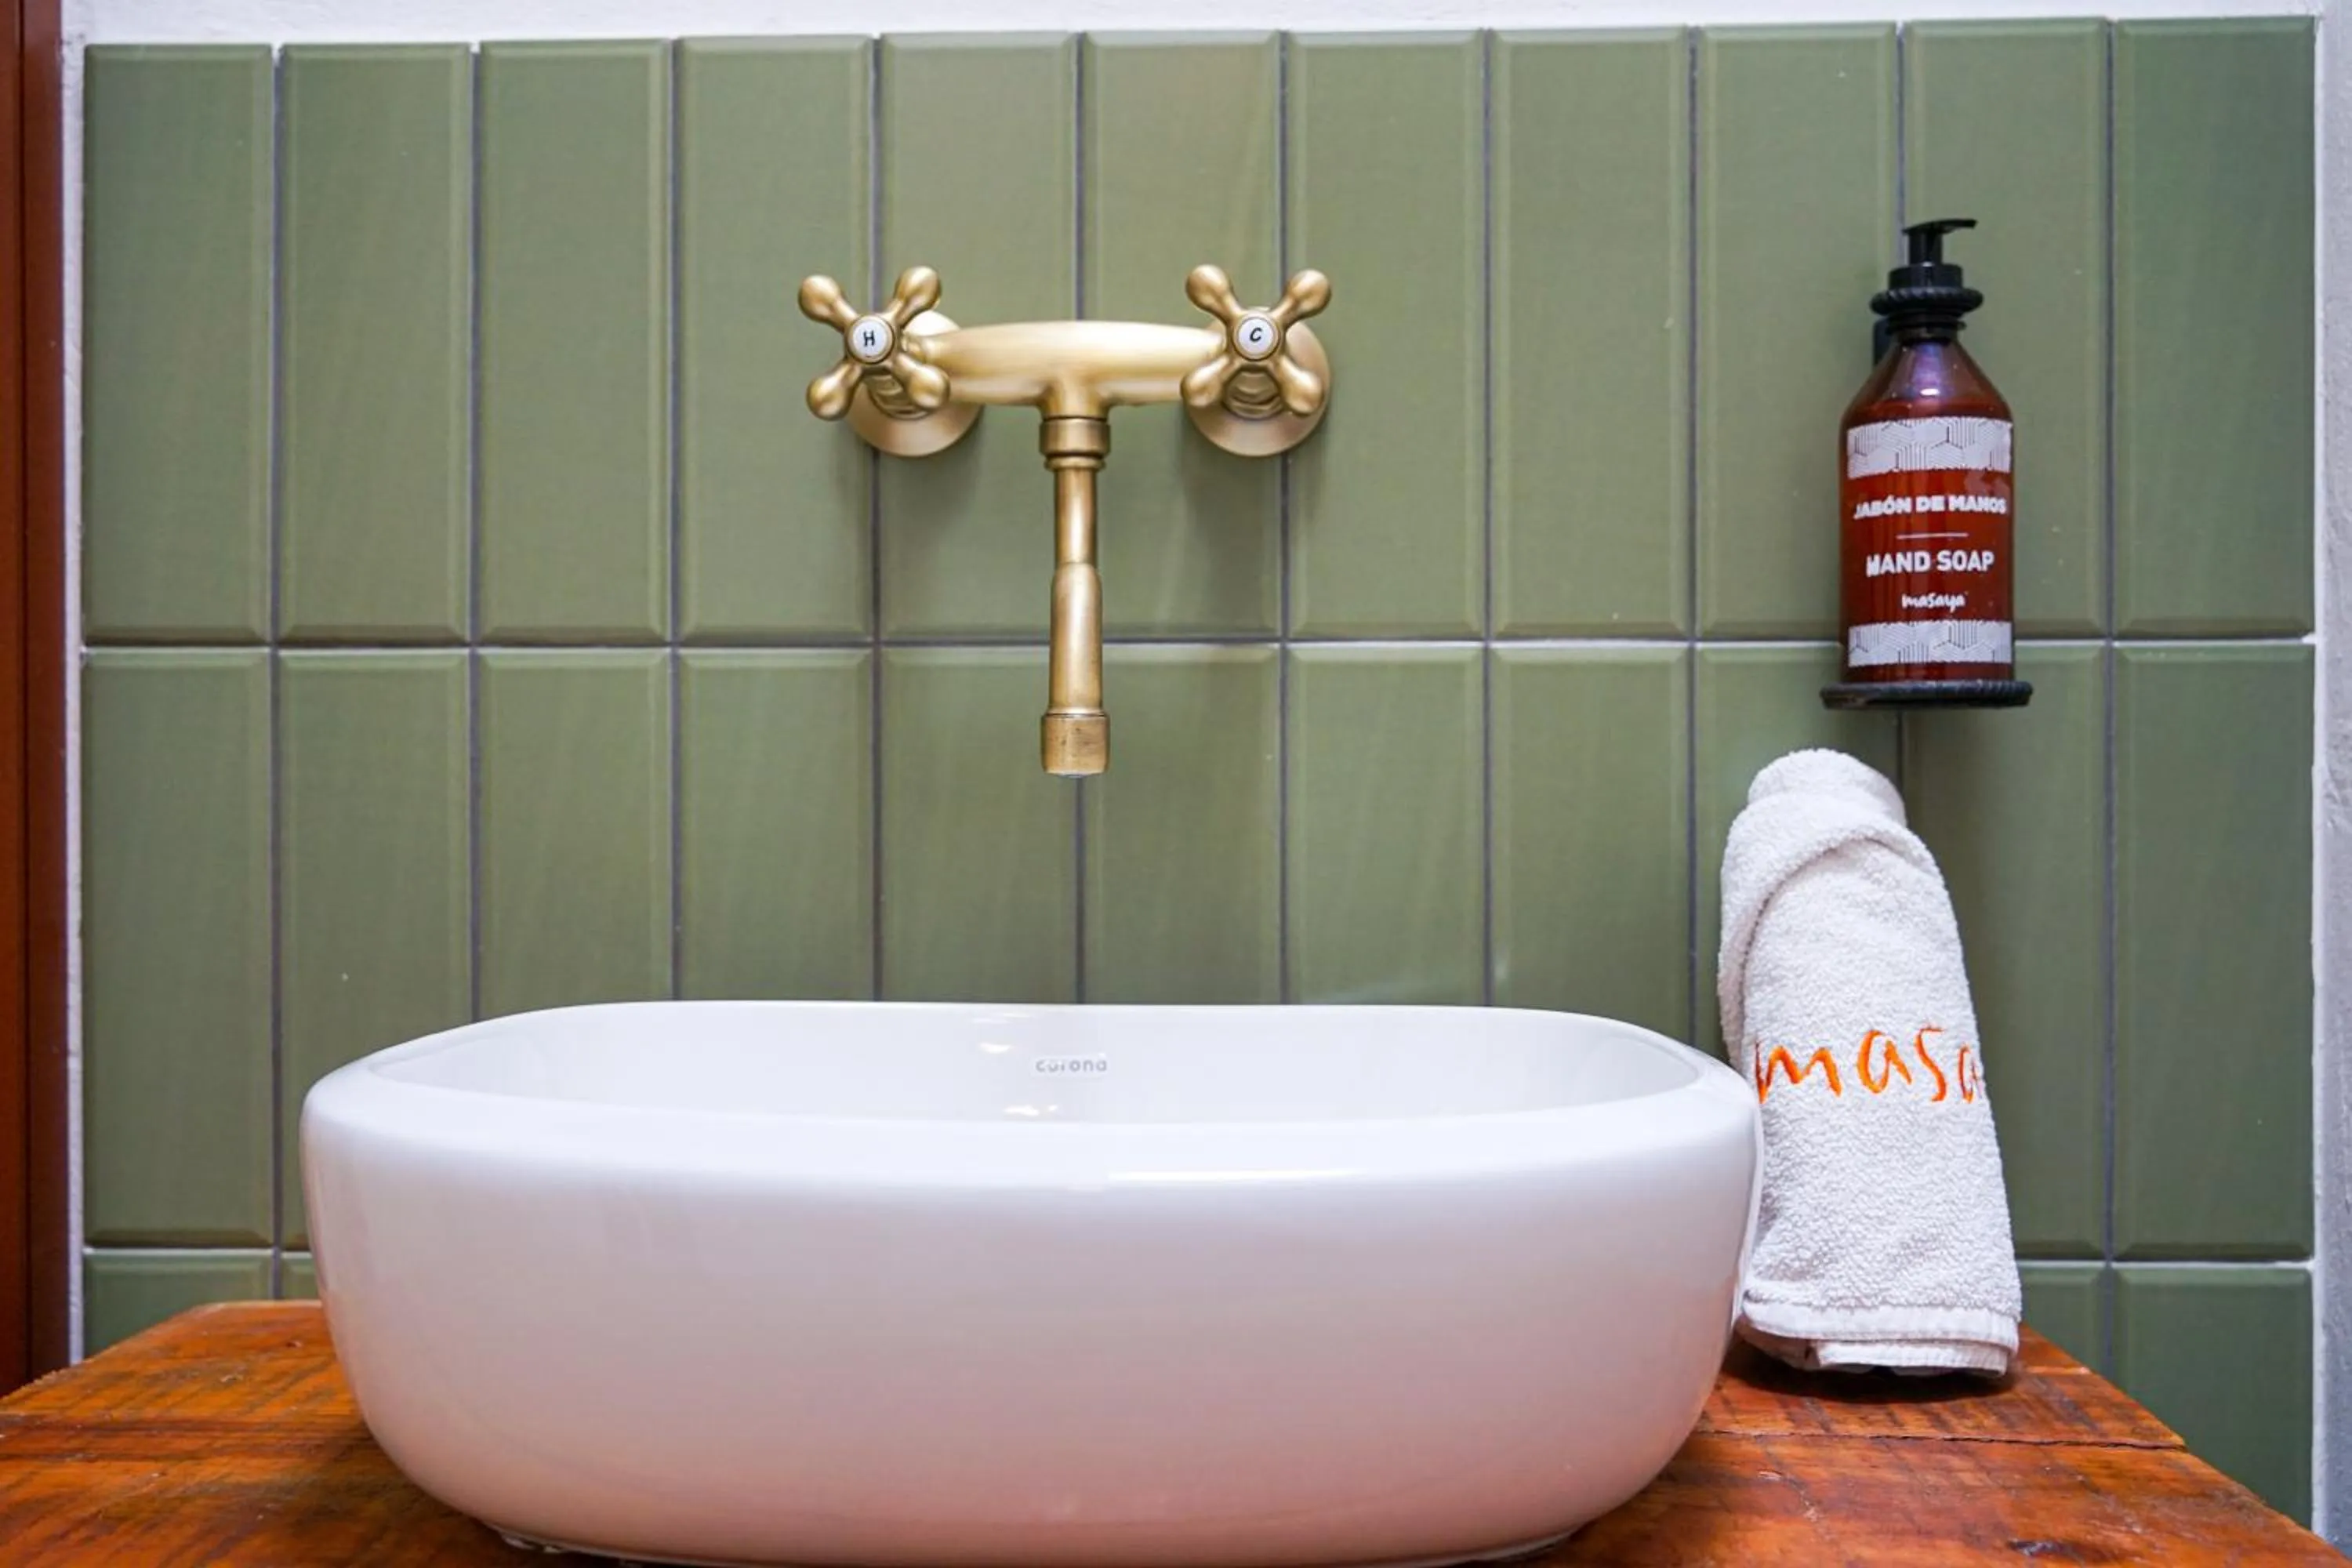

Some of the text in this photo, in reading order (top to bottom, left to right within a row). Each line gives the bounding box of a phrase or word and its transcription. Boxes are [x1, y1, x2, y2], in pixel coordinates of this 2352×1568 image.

[863, 330, 875, 347] H
[1250, 327, 1262, 342] C
[1853, 495, 2007, 519] JABÓN DE MANOS
[1866, 550, 1994, 577] HAND SOAP
[1036, 1058, 1107, 1073] corona
